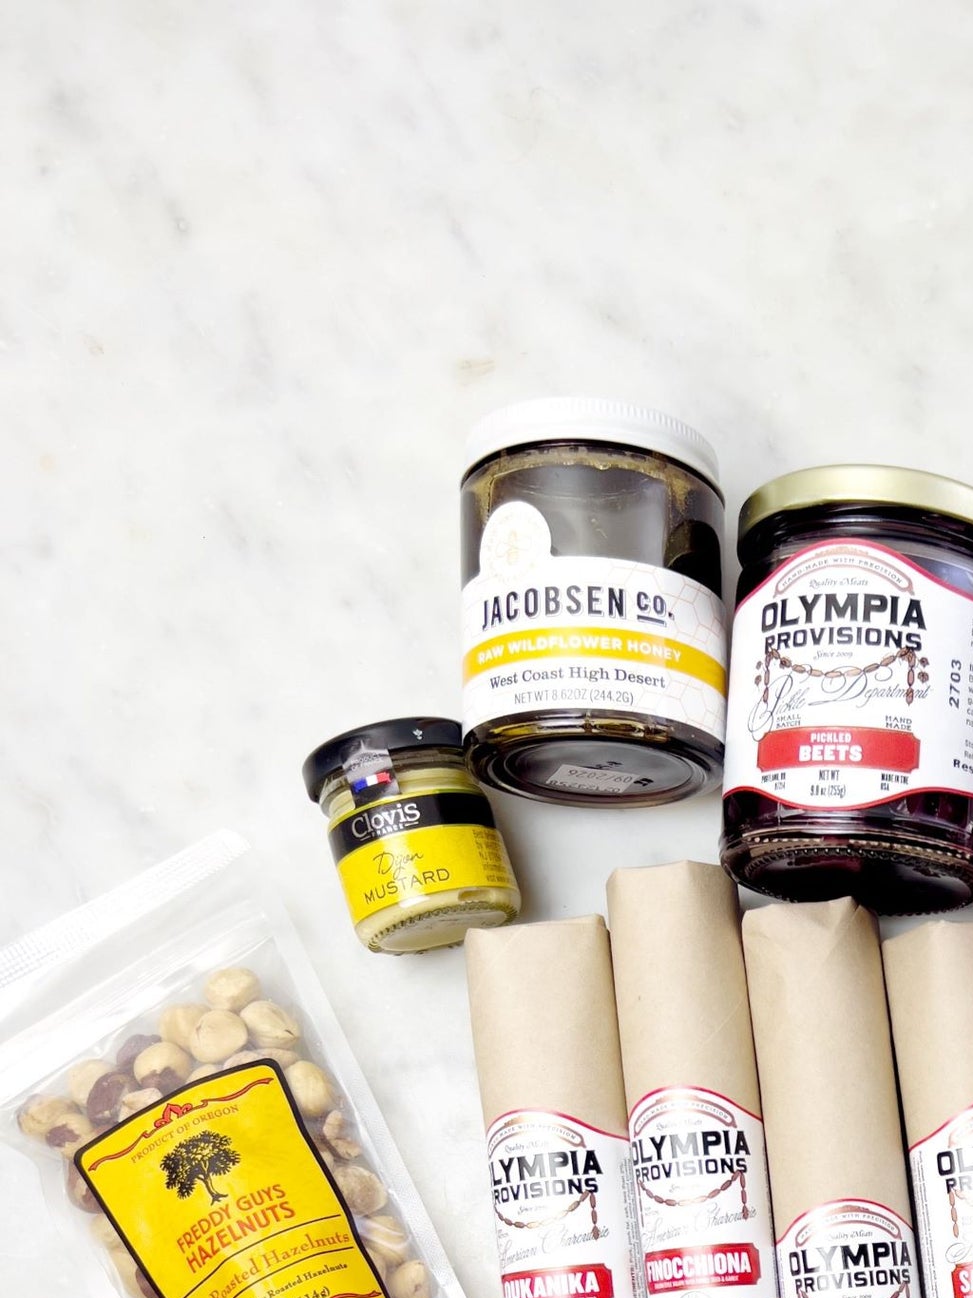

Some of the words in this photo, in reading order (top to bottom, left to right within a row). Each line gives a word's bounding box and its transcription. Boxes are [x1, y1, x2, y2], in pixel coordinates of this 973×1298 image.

[482, 586, 626, 630] JACOBSEN
[636, 592, 675, 624] CO.
[761, 593, 926, 633] OLYMPIA
[477, 646, 504, 664] RAW
[508, 637, 622, 655] WILDFLOWER
[627, 640, 681, 662] HONEY
[765, 627, 922, 653] PROVISIONS
[490, 673, 518, 690] West
[522, 668, 564, 682] Coast
[569, 667, 609, 682] High
[614, 669, 666, 688] Desert
[949, 659, 961, 709] 2703
[514, 691, 532, 704] NET
[534, 691, 550, 702] WT
[590, 690, 634, 705] (244.2G)
[885, 715, 912, 724] HAND
[886, 722, 912, 731] MADE
[810, 732, 851, 743] PICKLED
[799, 745, 863, 762] BEETS
[352, 803, 420, 838] Clovis
[373, 851, 424, 881] Dijon
[364, 868, 450, 904] MUSTARD
[131, 1131, 175, 1163] PRODUCT
[176, 1123, 191, 1134] OF
[192, 1105, 239, 1126] OREGON
[635, 1158, 747, 1183] PROVISIONS
[176, 1206, 232, 1254] FREDDY
[236, 1184, 287, 1212] GUYS
[186, 1201, 296, 1274] HAZELNUTS
[263, 1233, 350, 1269] Hazelnuts
[647, 1251, 751, 1283] FINOCCHIONA
[789, 1241, 912, 1276] OLYMPIA
[795, 1269, 911, 1294] PROVISIONS
